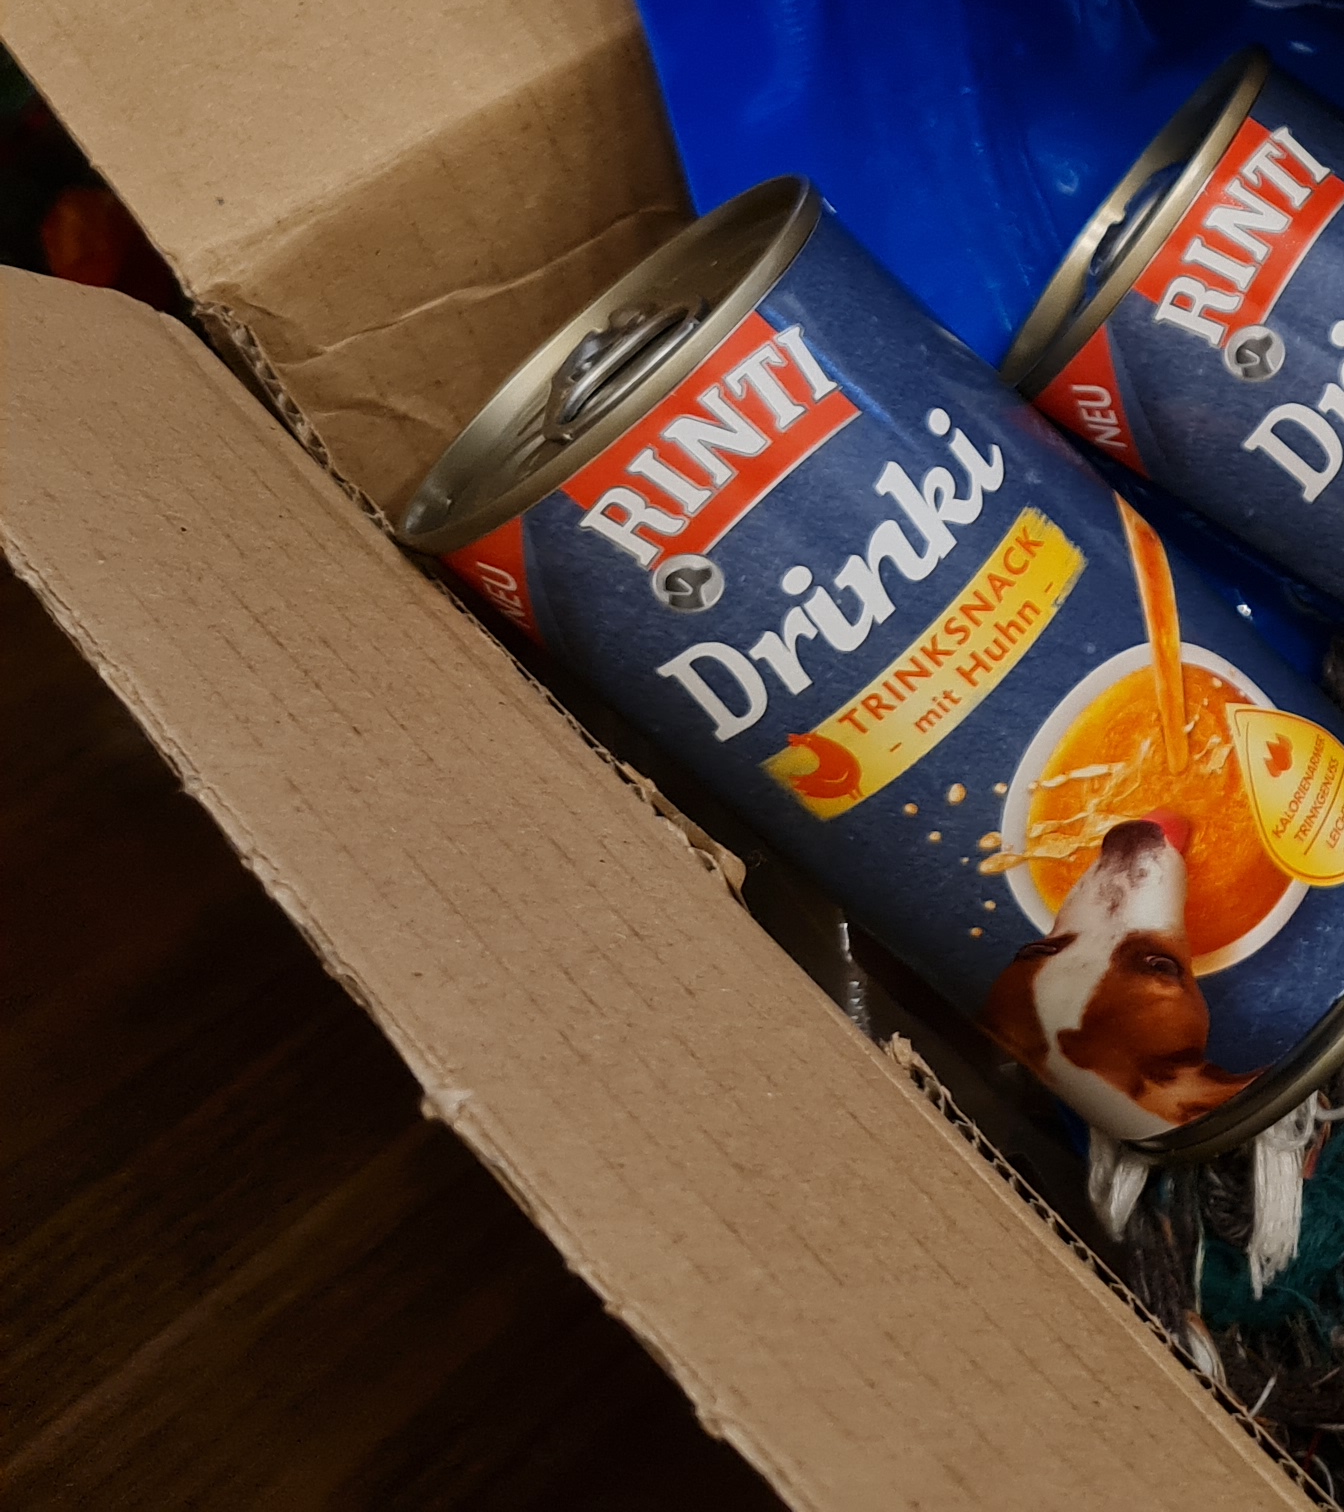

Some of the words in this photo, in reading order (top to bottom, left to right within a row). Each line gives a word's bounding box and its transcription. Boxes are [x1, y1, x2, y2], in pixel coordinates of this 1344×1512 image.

[1154, 124, 1333, 349] RINTI
[578, 323, 843, 568] RINTI
[1071, 383, 1129, 448] NEU
[656, 406, 1005, 744] Drinki
[836, 526, 1046, 737] TRINKSNACK
[912, 689, 964, 736] mit
[957, 597, 1042, 691] Huhn
[1271, 733, 1326, 840] KALORIENARMER
[1293, 756, 1341, 844] TRINKGENUSS
